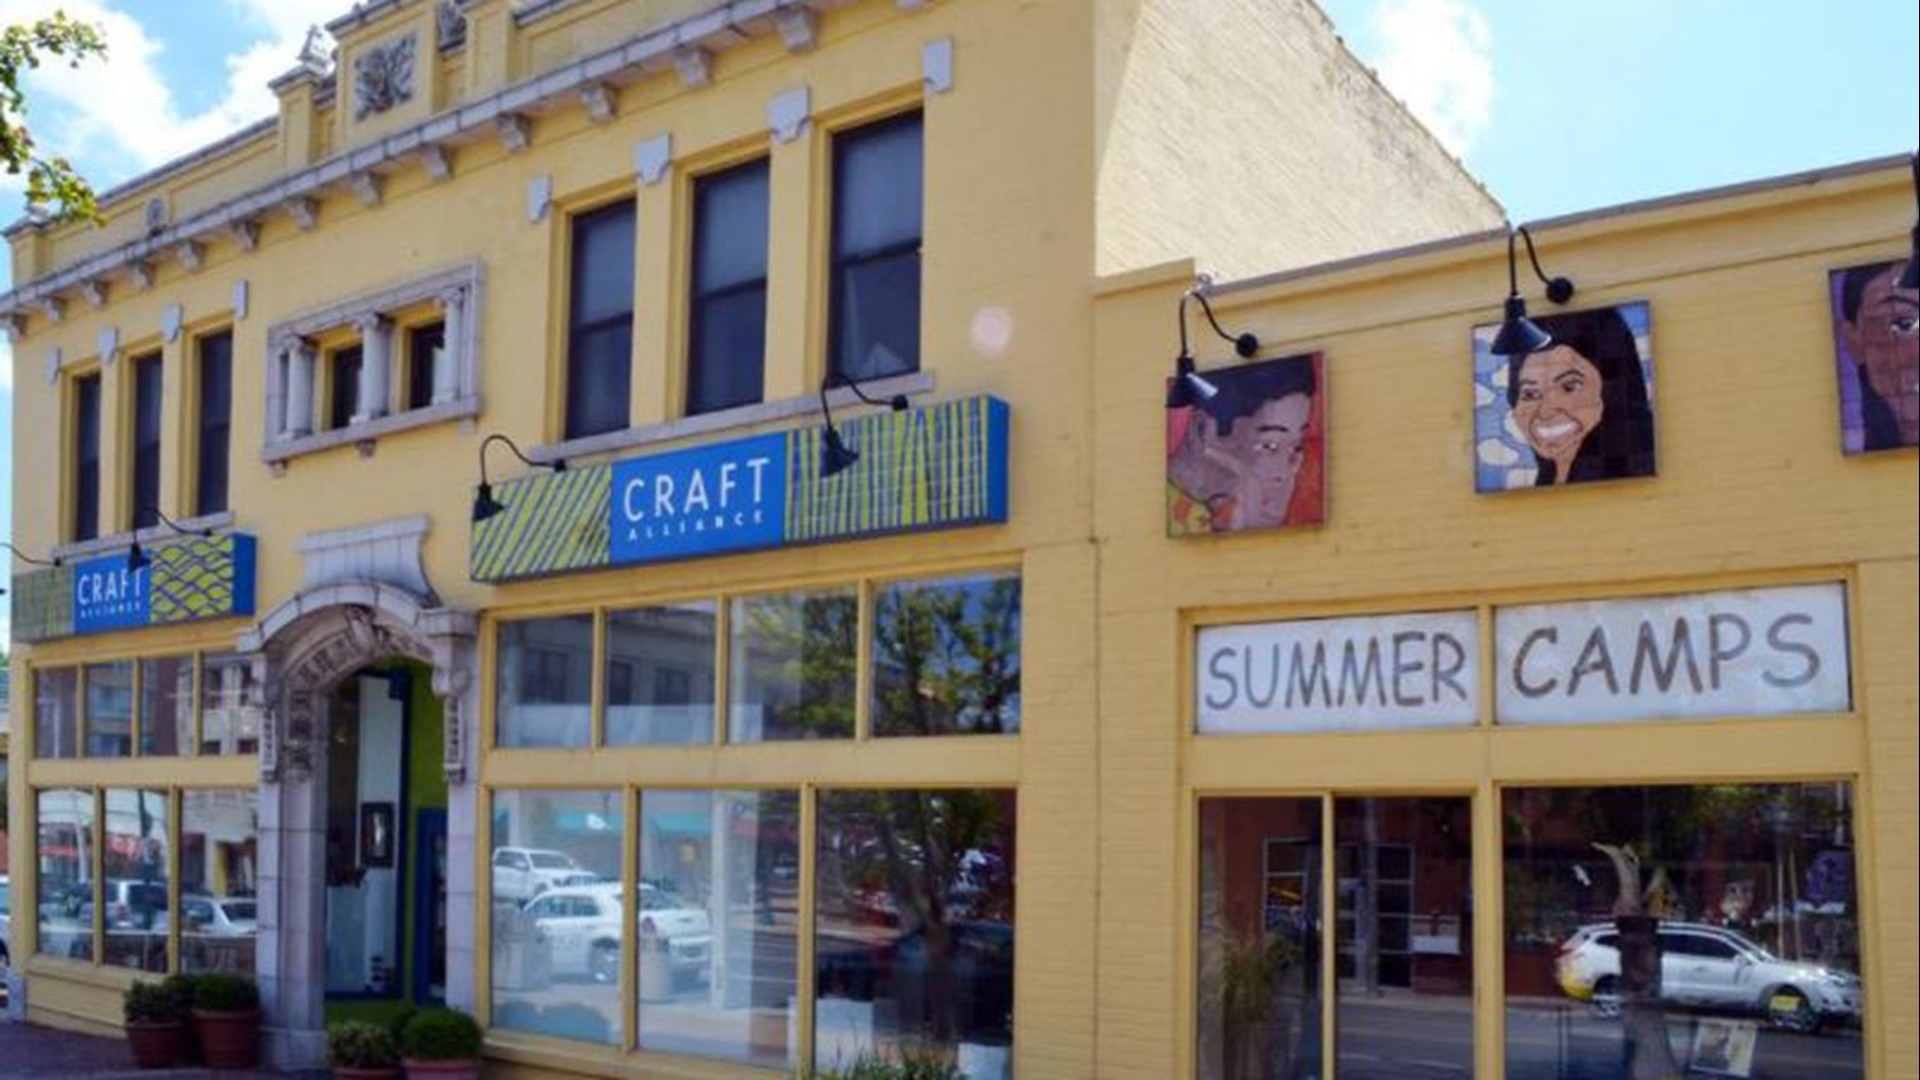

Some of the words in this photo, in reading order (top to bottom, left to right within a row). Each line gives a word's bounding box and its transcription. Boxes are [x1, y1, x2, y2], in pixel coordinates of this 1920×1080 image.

[623, 457, 771, 522] CRAFT
[628, 509, 763, 541] ALLIANCE
[78, 567, 145, 606] CRAFT
[1204, 630, 1468, 710] SUMMER
[1512, 612, 1821, 699] CAMPS
